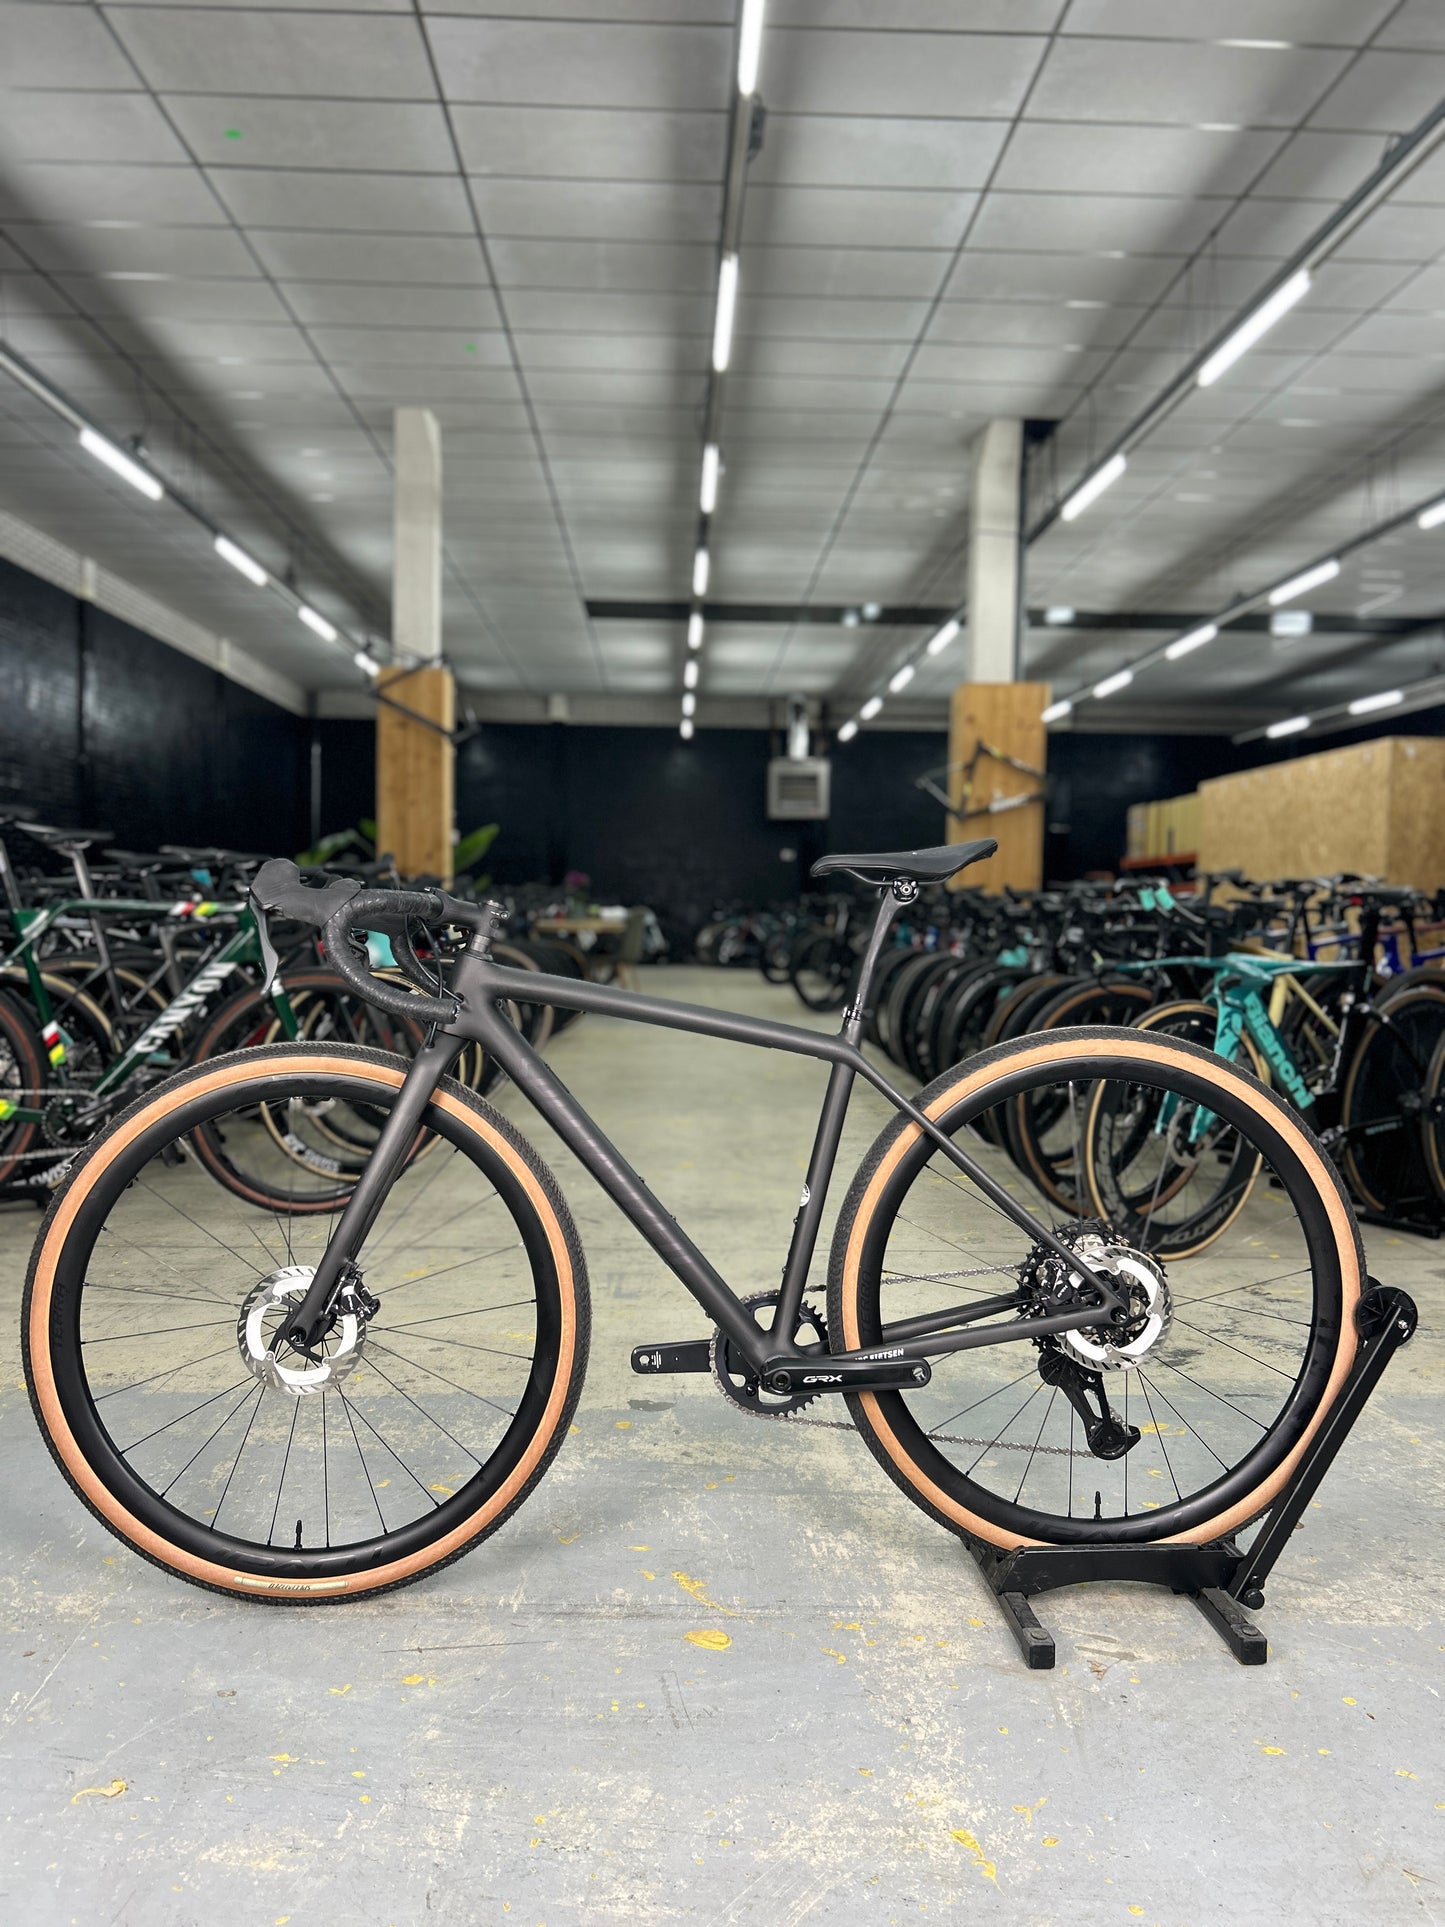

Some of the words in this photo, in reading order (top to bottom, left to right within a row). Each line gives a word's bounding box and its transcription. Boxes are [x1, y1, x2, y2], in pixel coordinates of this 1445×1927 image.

[134, 962, 238, 1053] CANYON
[1243, 991, 1316, 1110] Bianchi
[802, 1374, 843, 1383] GRX
